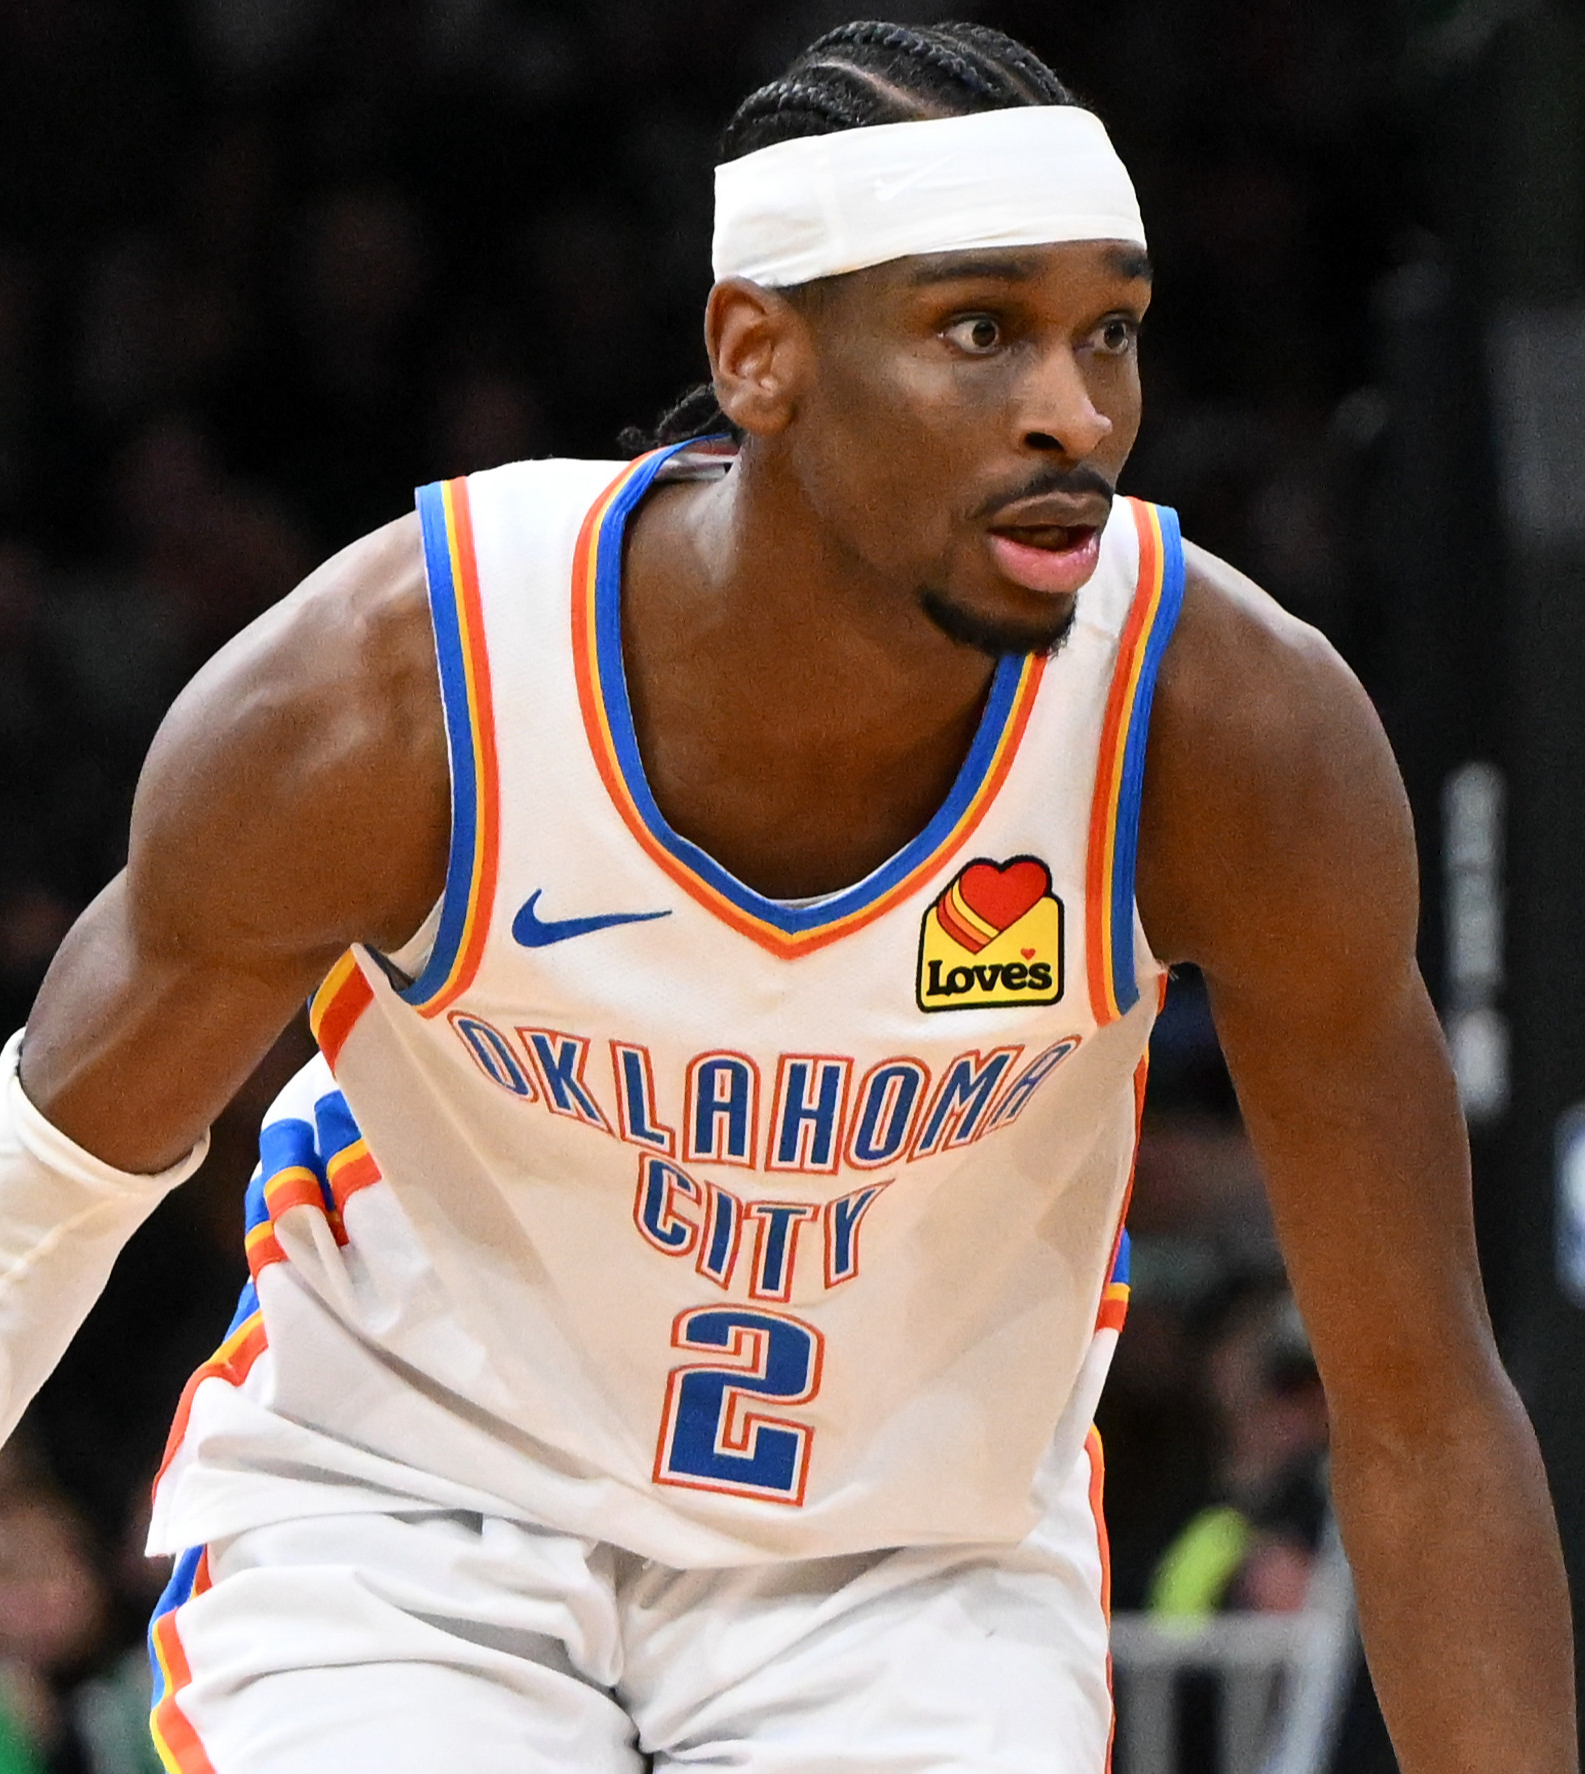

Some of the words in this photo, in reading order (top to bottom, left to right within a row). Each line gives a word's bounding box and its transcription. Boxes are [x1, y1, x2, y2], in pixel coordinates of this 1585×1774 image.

[926, 959, 1053, 996] Loves
[446, 1008, 1083, 1175] OKLAHOMA
[634, 1152, 896, 1302] CITY
[652, 1304, 824, 1506] 2
